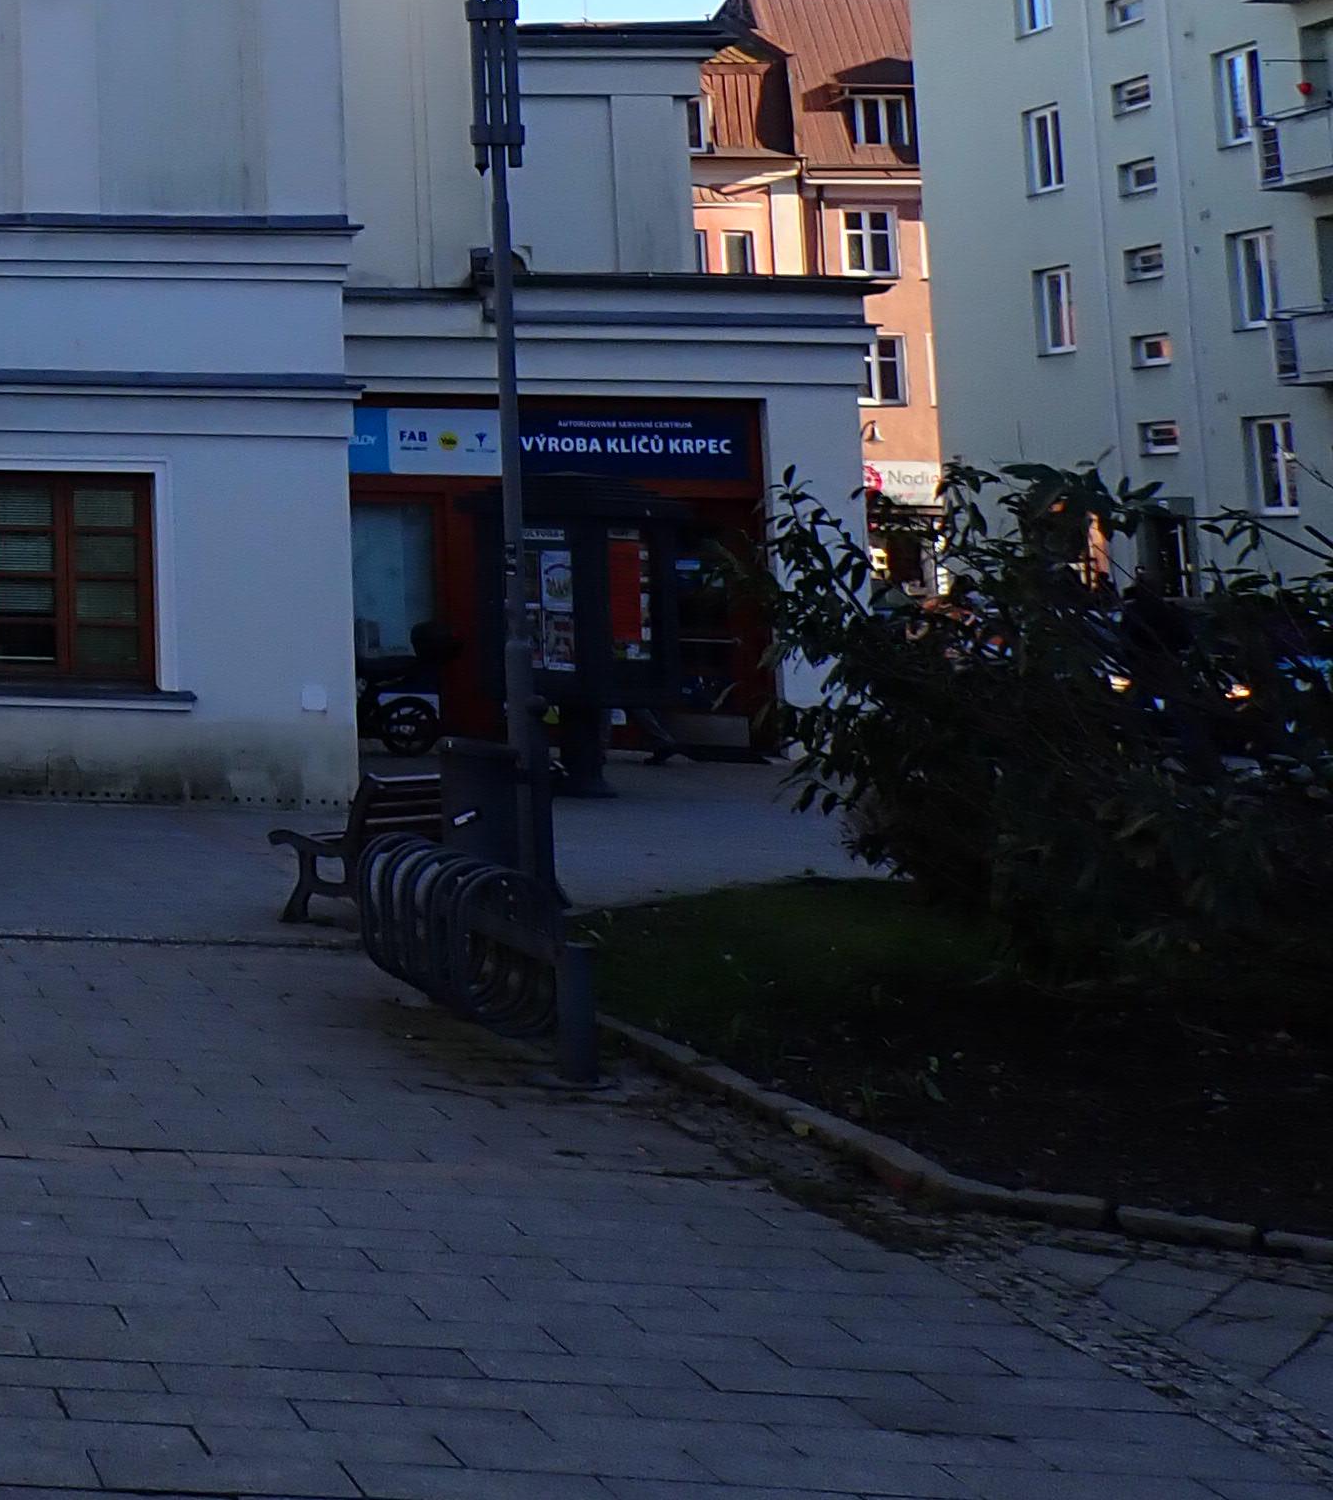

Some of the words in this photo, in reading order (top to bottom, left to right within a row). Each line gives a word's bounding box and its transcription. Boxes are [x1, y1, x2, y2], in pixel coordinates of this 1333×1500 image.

[399, 430, 428, 442] FAB
[520, 433, 603, 453] VÝROBA
[607, 434, 663, 454] KLÍČŮ
[669, 437, 732, 454] KRPEC
